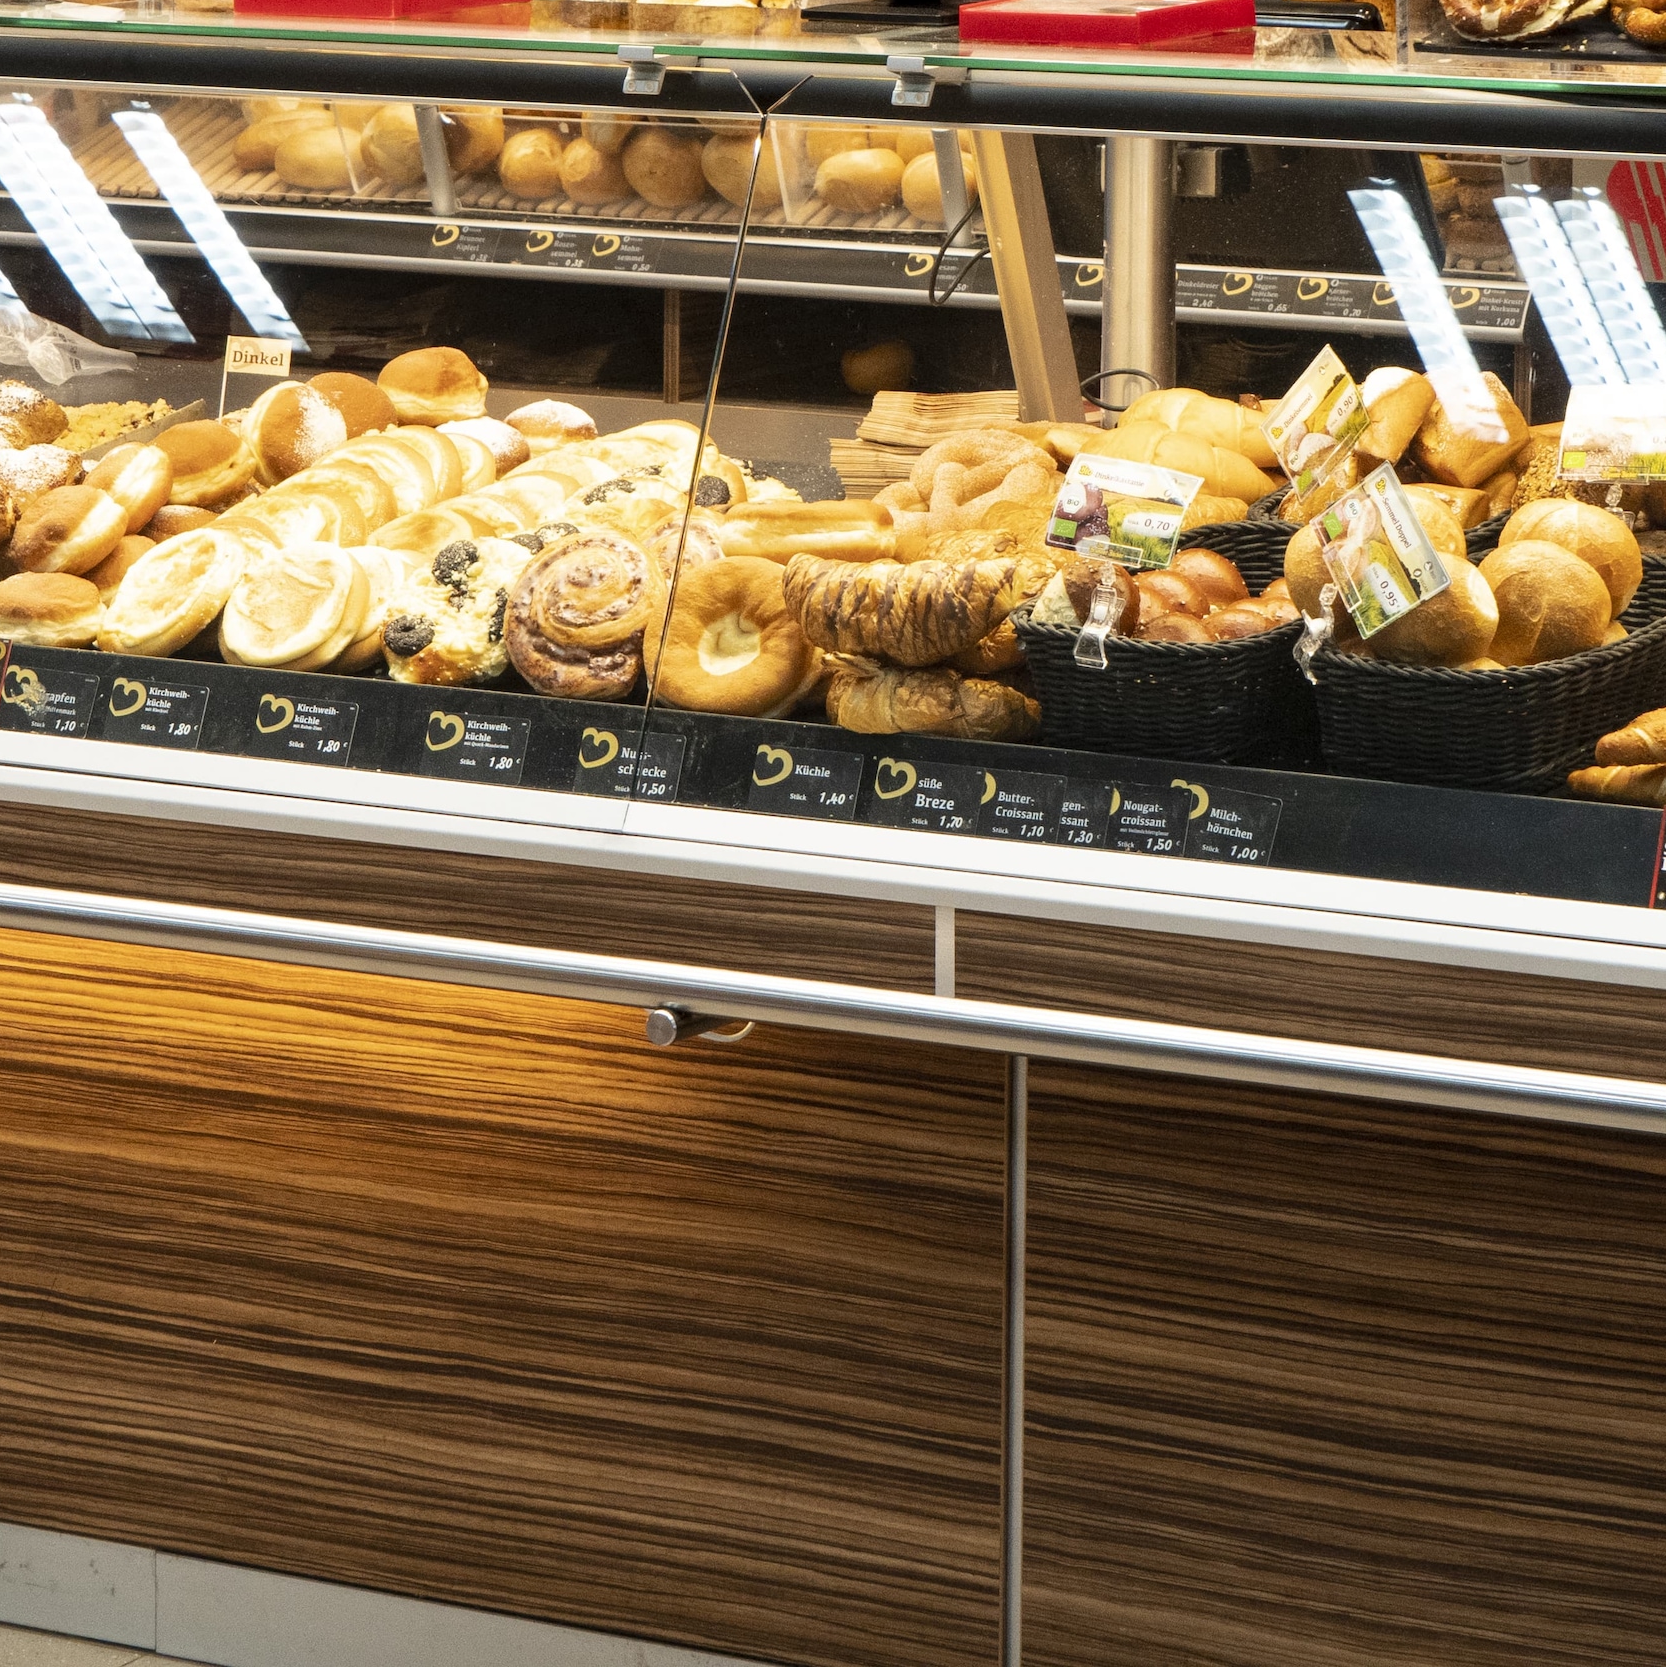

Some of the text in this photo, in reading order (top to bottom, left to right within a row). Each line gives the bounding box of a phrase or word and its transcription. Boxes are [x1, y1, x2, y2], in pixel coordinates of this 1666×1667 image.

[233, 351, 283, 366] Dinkel
[1396, 524, 1412, 549] Doppel
[1380, 581, 1398, 607] 0,95
[43, 692, 76, 704] rapfen
[149, 687, 190, 699] Kirchweih-
[146, 698, 171, 709] küchle
[297, 703, 339, 715] Kirchweih-
[294, 715, 320, 725] küchle
[467, 720, 511, 732] Kirchweih-
[168, 722, 191, 735] 1,80
[465, 732, 491, 742] küchle
[316, 739, 341, 752] 1,80
[488, 757, 513, 769] 1,80
[618, 765, 667, 778] schecke
[795, 764, 830, 778] Küchle
[640, 783, 665, 796] 1,50
[918, 778, 942, 790] süße
[819, 791, 846, 805] 1,40
[915, 793, 955, 811] Breze
[998, 791, 1035, 806] Butter-
[995, 806, 1044, 821] Croissant
[1123, 800, 1163, 814] Nougat-
[939, 815, 962, 828] 1,70
[1121, 815, 1166, 828] croissant
[1210, 808, 1242, 823] Milch-
[1019, 824, 1044, 836] 1,10
[1206, 822, 1253, 840] hörnchen
[1066, 830, 1094, 844] 1,30
[1146, 838, 1172, 851] 1,50
[1229, 845, 1258, 861] 1,00
